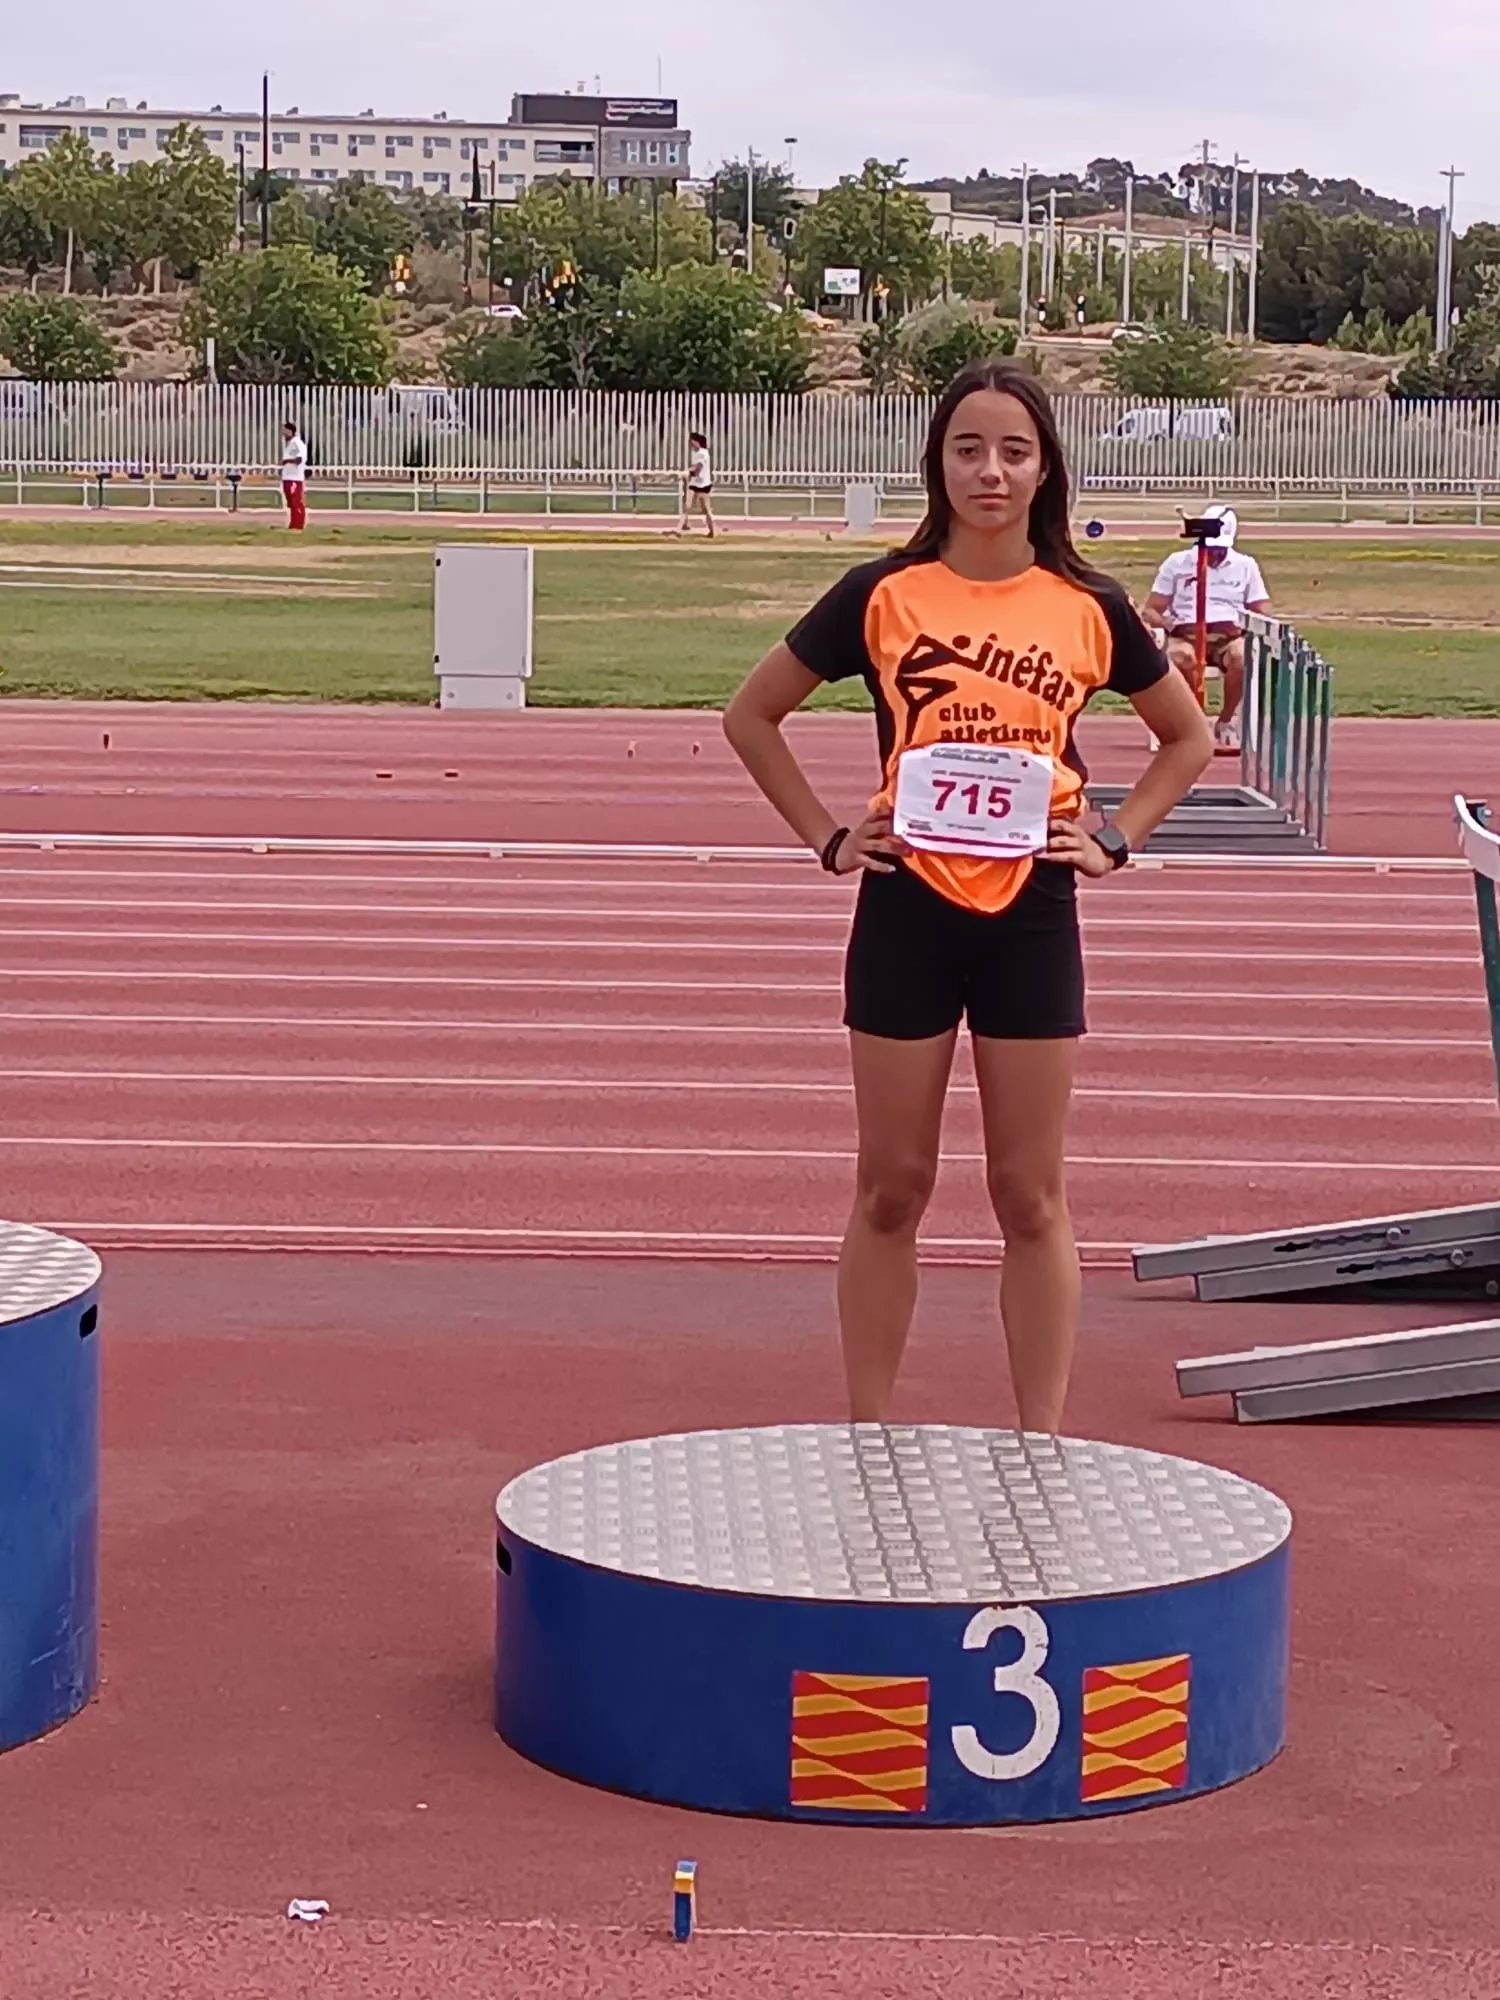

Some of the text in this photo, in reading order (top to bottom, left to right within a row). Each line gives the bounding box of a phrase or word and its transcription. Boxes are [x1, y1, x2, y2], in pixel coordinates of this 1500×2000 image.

[939, 702, 996, 721] club
[932, 779, 1012, 818] 715
[951, 1605, 1061, 1780] 3
